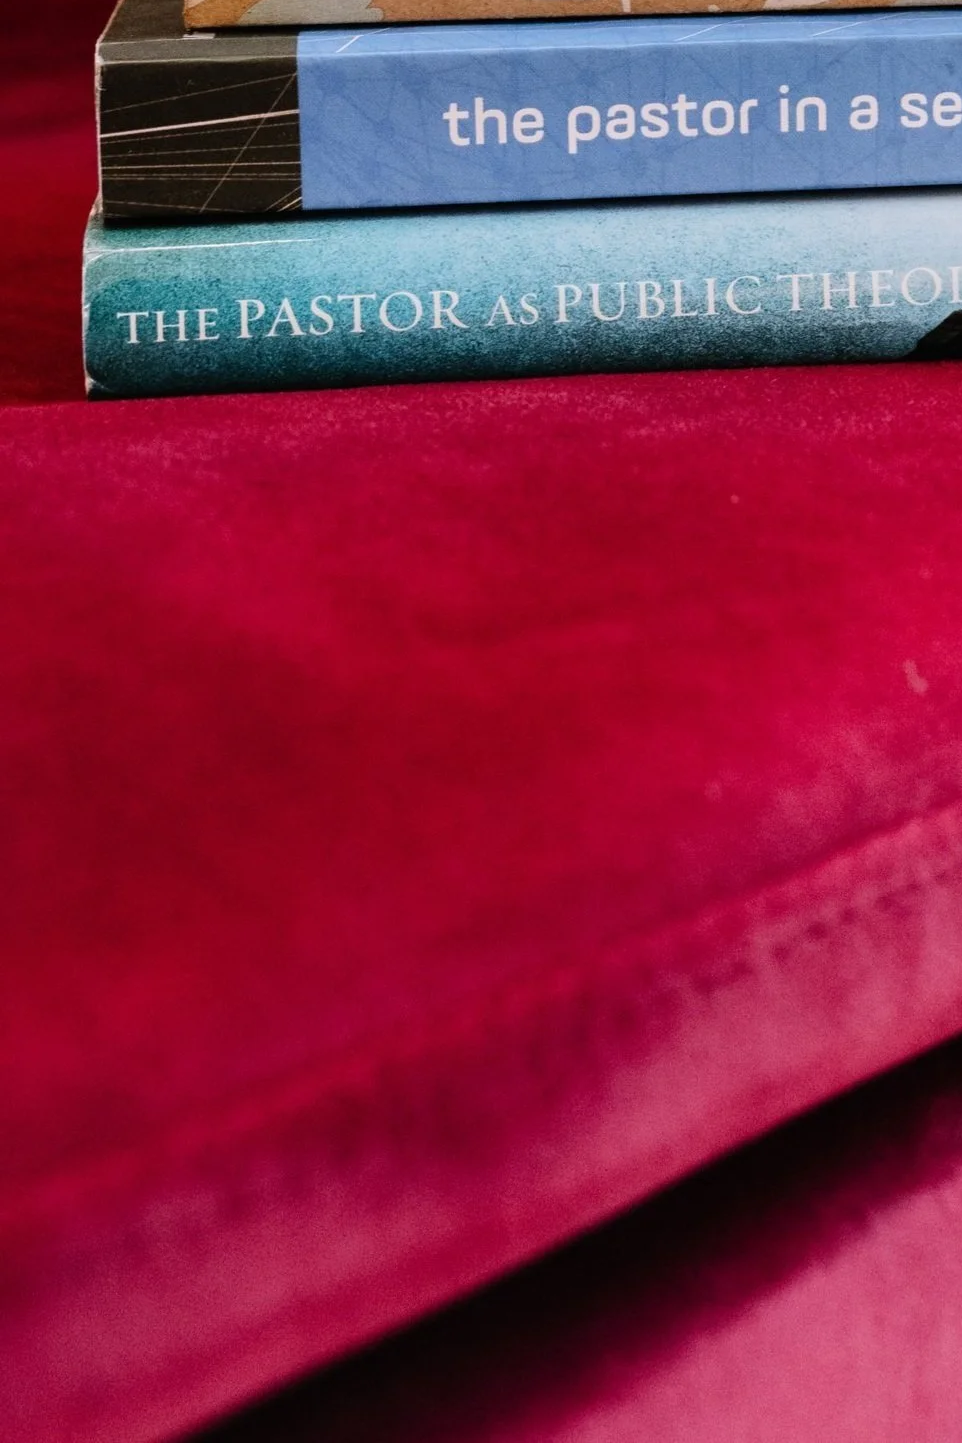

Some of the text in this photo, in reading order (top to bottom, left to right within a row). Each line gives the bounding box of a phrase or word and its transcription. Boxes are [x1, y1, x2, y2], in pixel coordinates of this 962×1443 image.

[442, 97, 545, 146] the
[567, 93, 758, 155] pastor
[778, 84, 827, 133] in
[849, 94, 879, 131] a
[115, 307, 221, 345] THE
[236, 289, 471, 340] PASTOR
[484, 292, 540, 327] AS
[553, 274, 764, 325] PUBLIC
